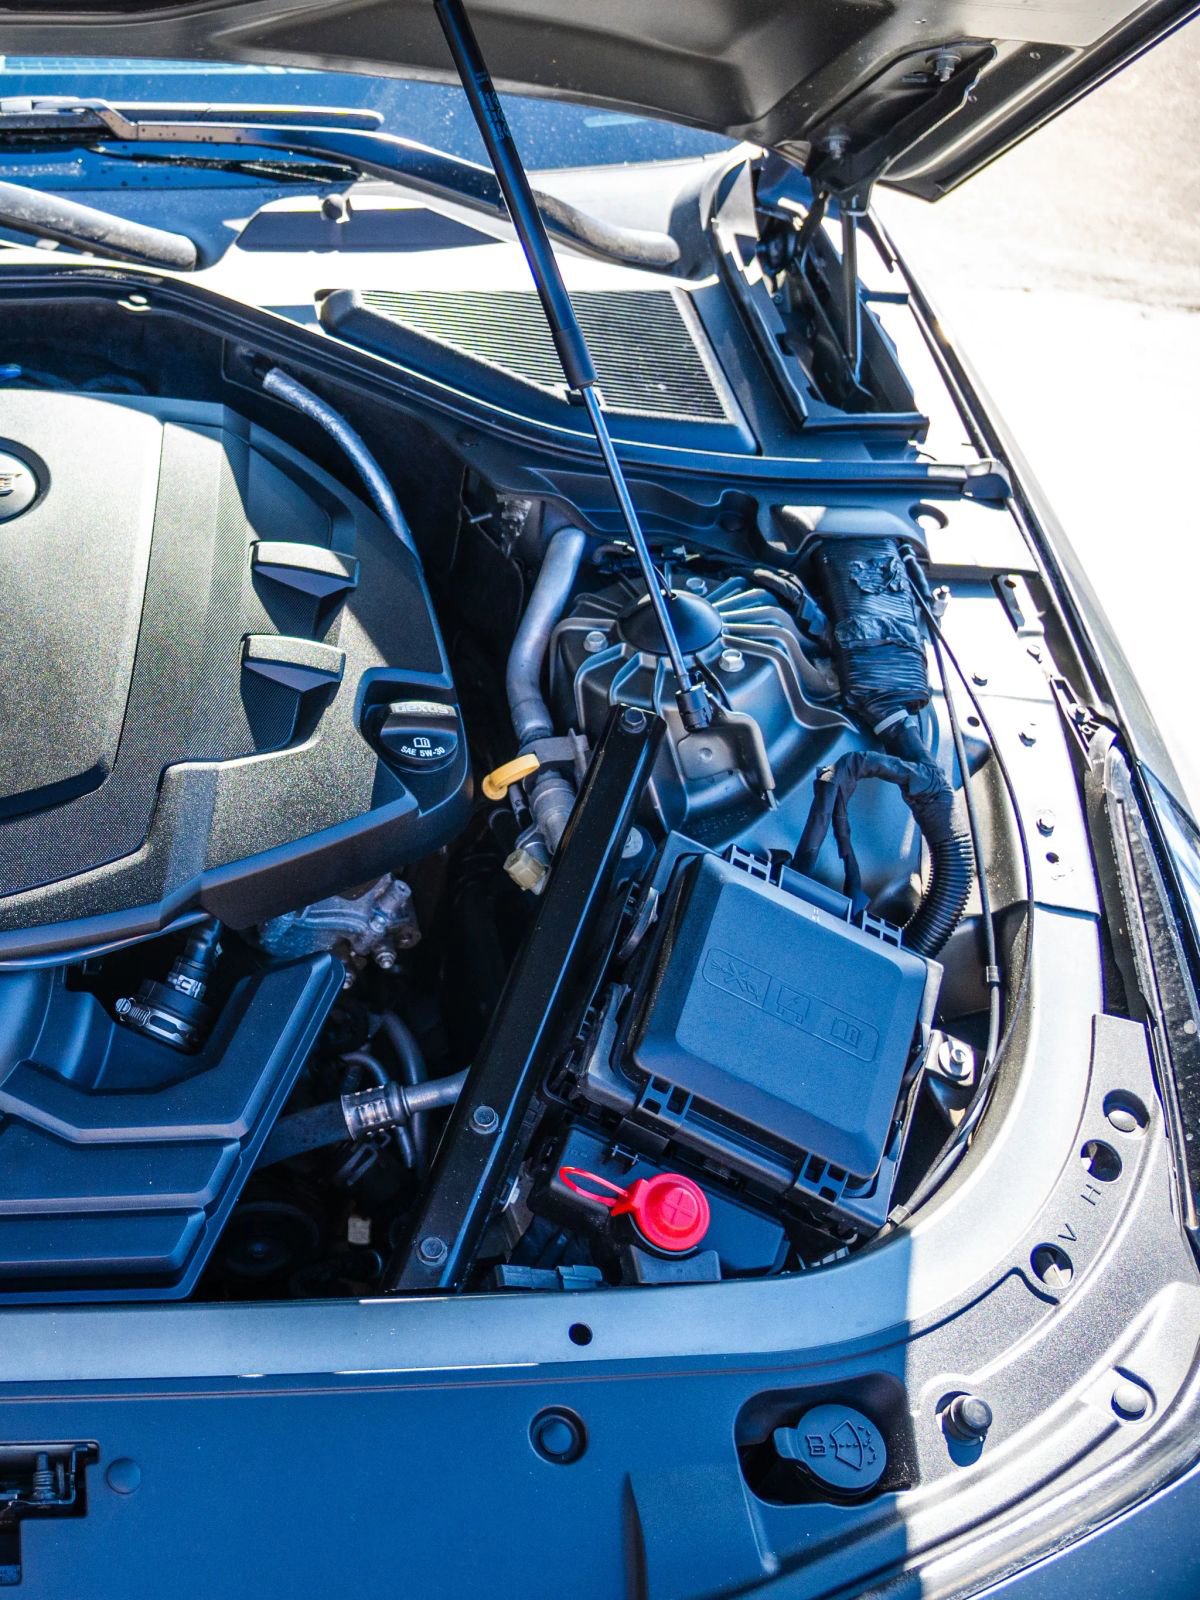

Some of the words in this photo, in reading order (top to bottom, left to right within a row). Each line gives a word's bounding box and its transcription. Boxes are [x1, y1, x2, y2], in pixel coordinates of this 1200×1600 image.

[400, 745, 417, 756] SAE
[419, 746, 446, 757] 5W-30
[1058, 1223, 1078, 1242] V
